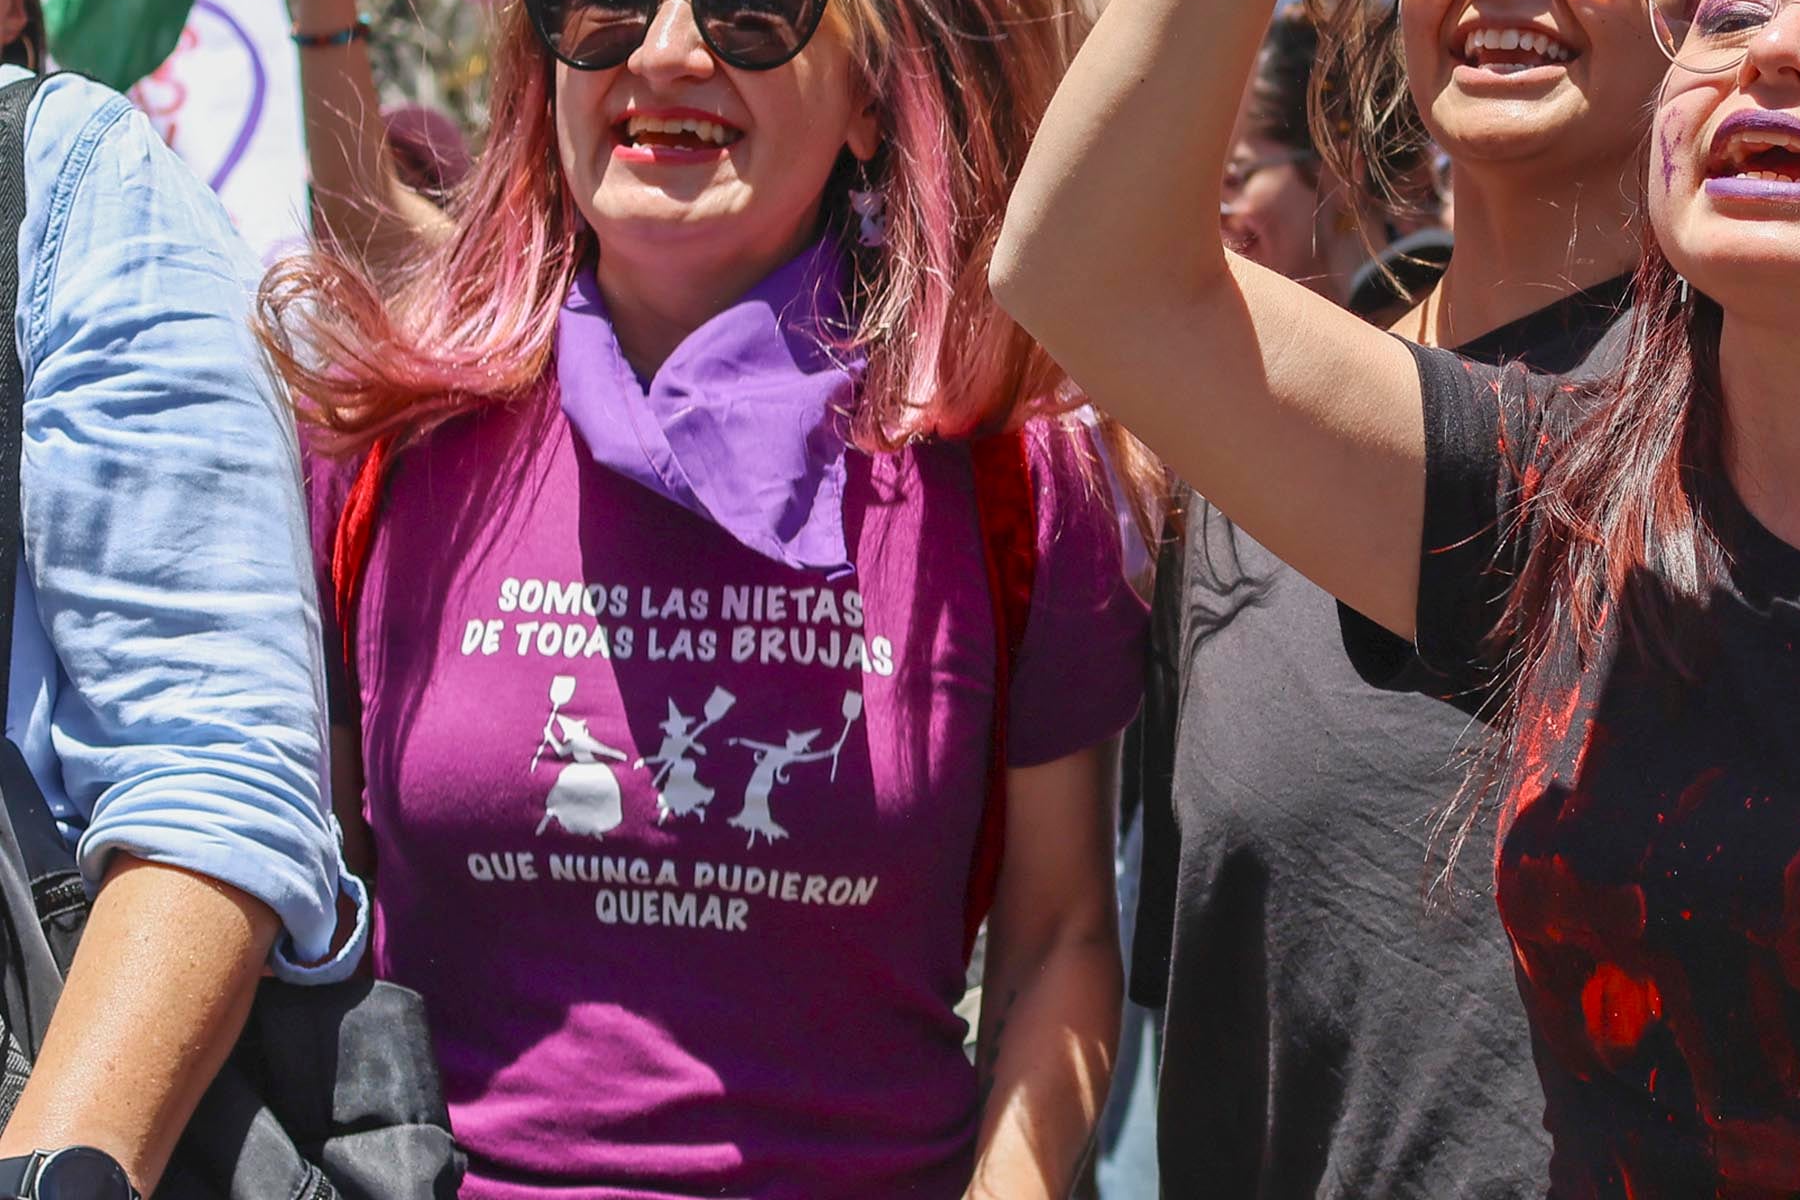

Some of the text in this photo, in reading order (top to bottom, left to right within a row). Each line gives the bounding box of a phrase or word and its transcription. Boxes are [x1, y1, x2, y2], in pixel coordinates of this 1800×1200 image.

[498, 577, 864, 628] SOMOS LAS NIETAS
[461, 619, 894, 677] DE TODAS LAS BRUJAS
[468, 851, 878, 907] QUE NUNCA PUDIERON
[595, 889, 749, 932] QUEMAR
